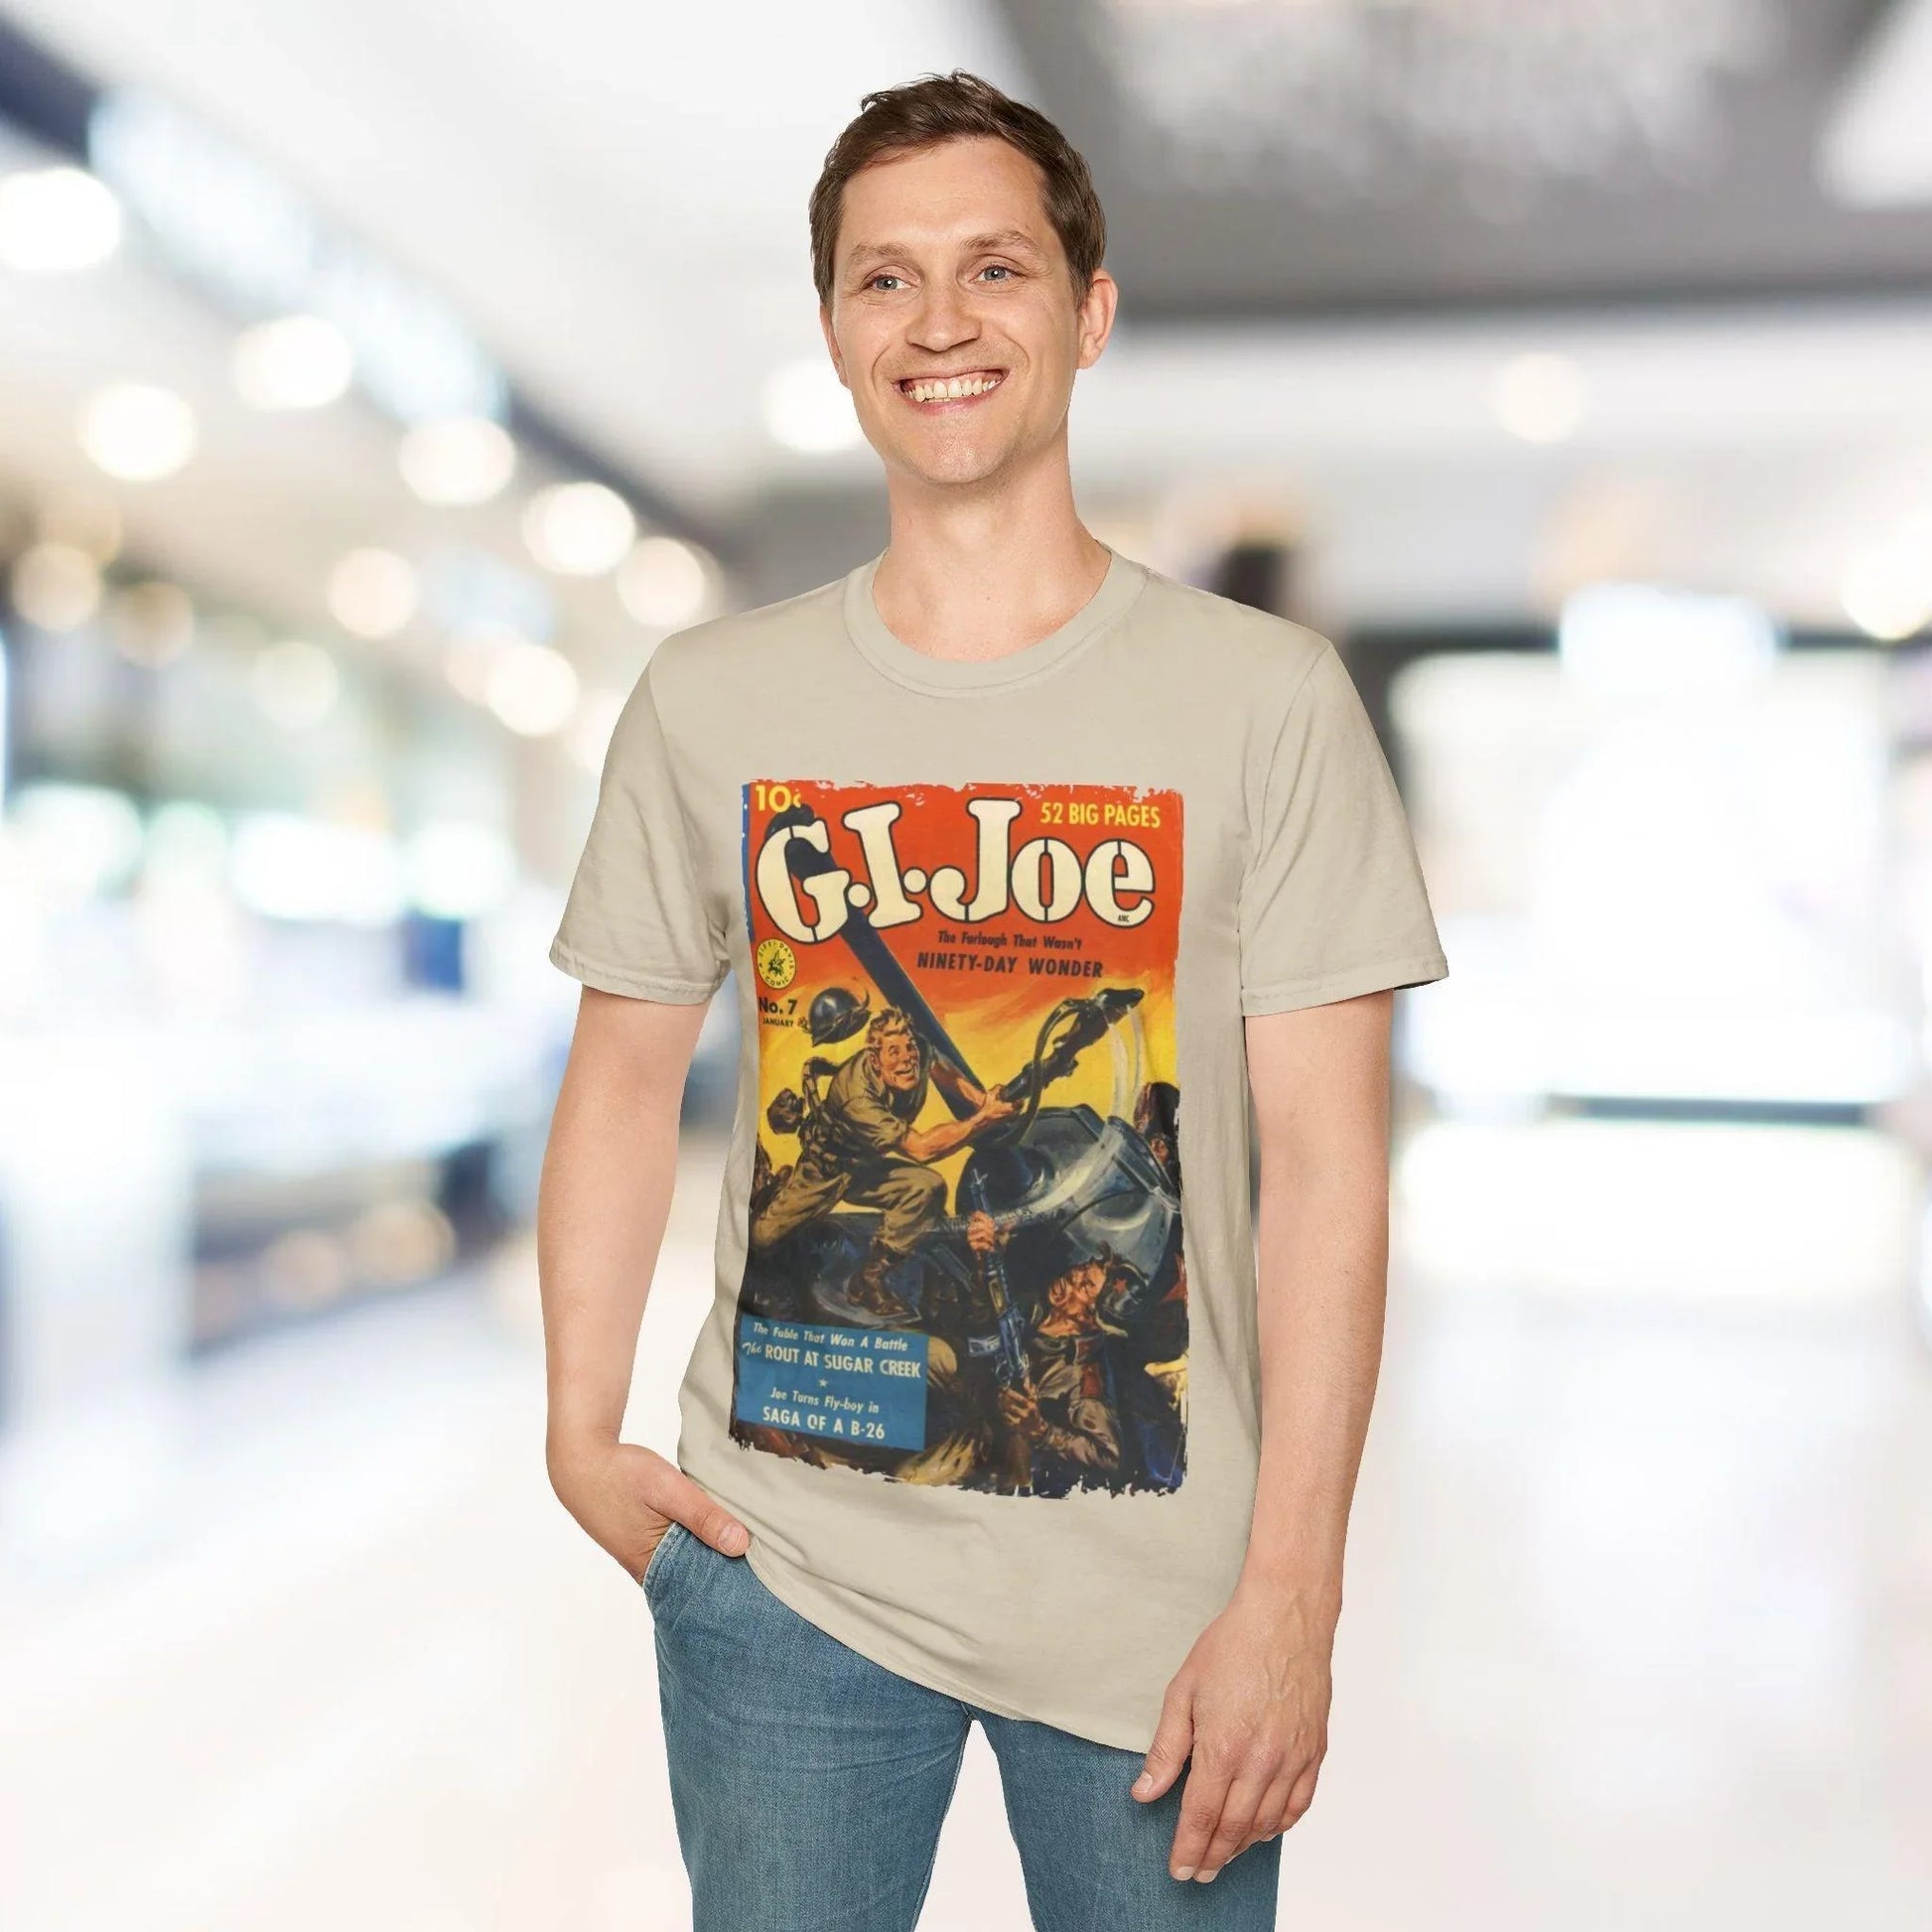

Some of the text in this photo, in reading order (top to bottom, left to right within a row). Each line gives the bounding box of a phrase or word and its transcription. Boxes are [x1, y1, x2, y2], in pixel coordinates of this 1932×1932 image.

[1040, 802, 1161, 828] 52 BIG PAGES
[938, 931, 956, 943] The
[1013, 934, 1036, 948] That
[1043, 936, 1082, 950] Wasn't
[917, 952, 1103, 978] NINETY-DAY WONDER
[759, 997, 797, 1015] No. 7
[762, 1018, 794, 1028] JANUARY
[754, 1322, 908, 1351] The Fable That Won A Battle
[742, 1341, 921, 1378] The ROUT AT SUGAR CREEK
[770, 1387, 880, 1414] Joe Turns Fly-boy in
[762, 1406, 886, 1440] SAGA OF A B-26
